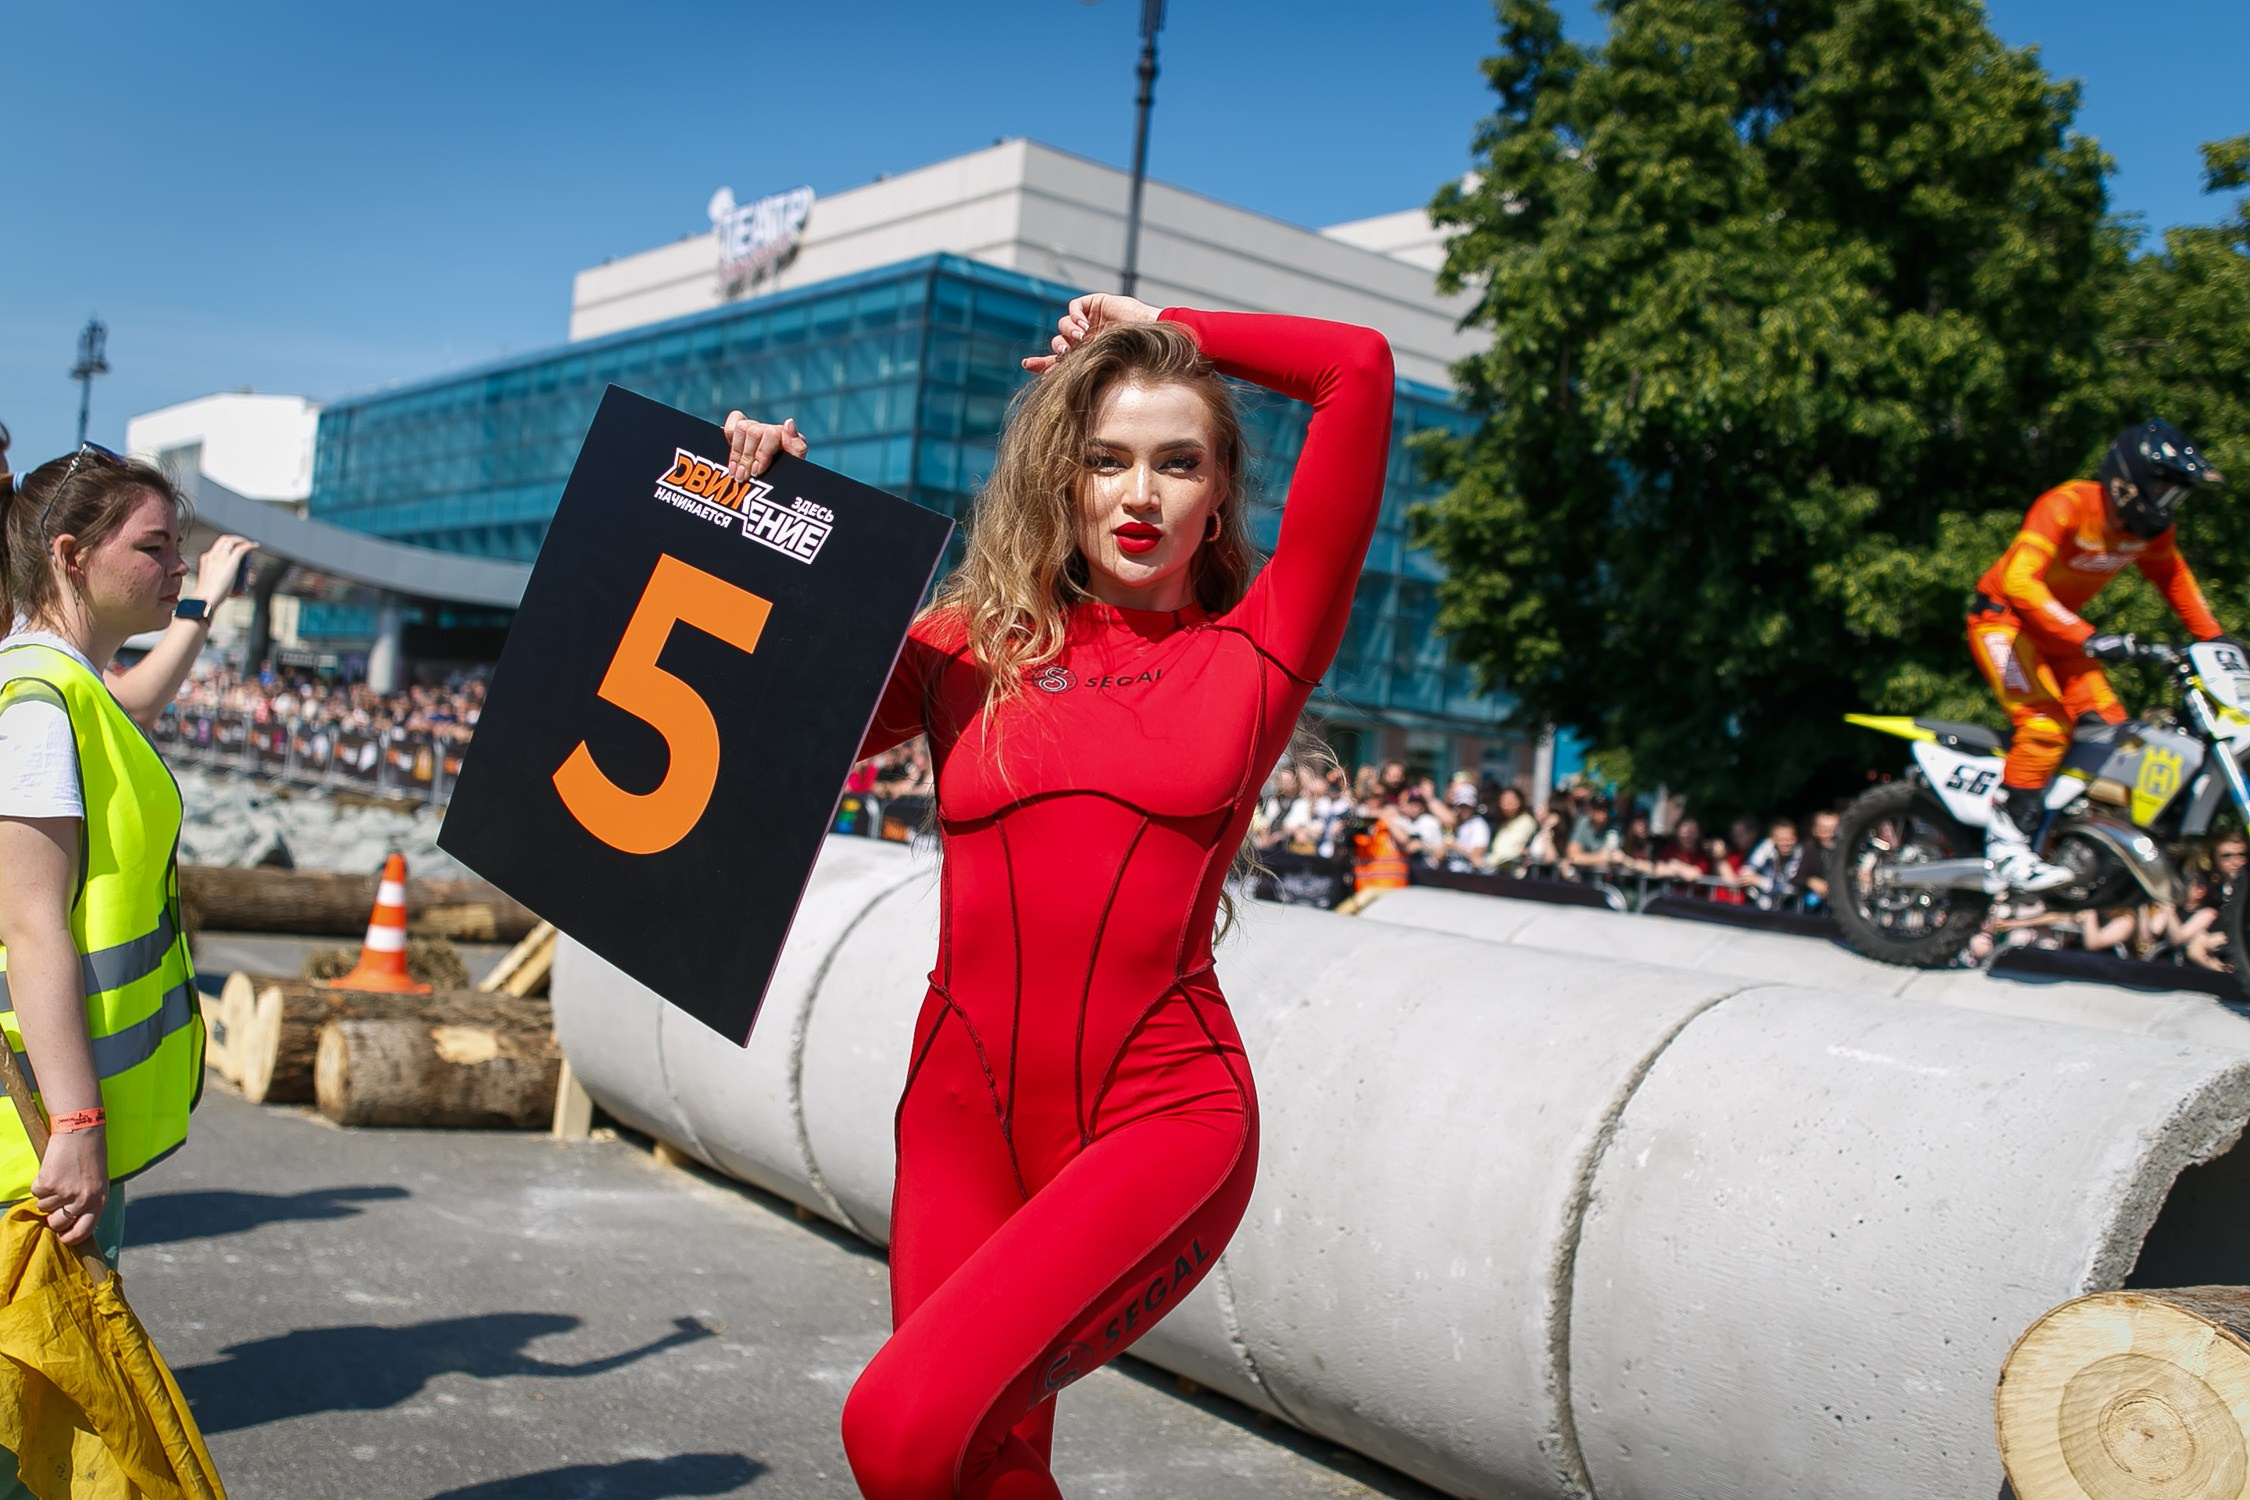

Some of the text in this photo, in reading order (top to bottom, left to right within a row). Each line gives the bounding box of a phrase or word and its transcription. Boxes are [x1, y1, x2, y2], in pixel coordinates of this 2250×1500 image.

[653, 487, 733, 529] НАЧИНАЕТСЯ
[790, 496, 835, 523] ЗДЕСЬ
[553, 554, 772, 854] 5
[1103, 1238, 1211, 1350] SEGAL
